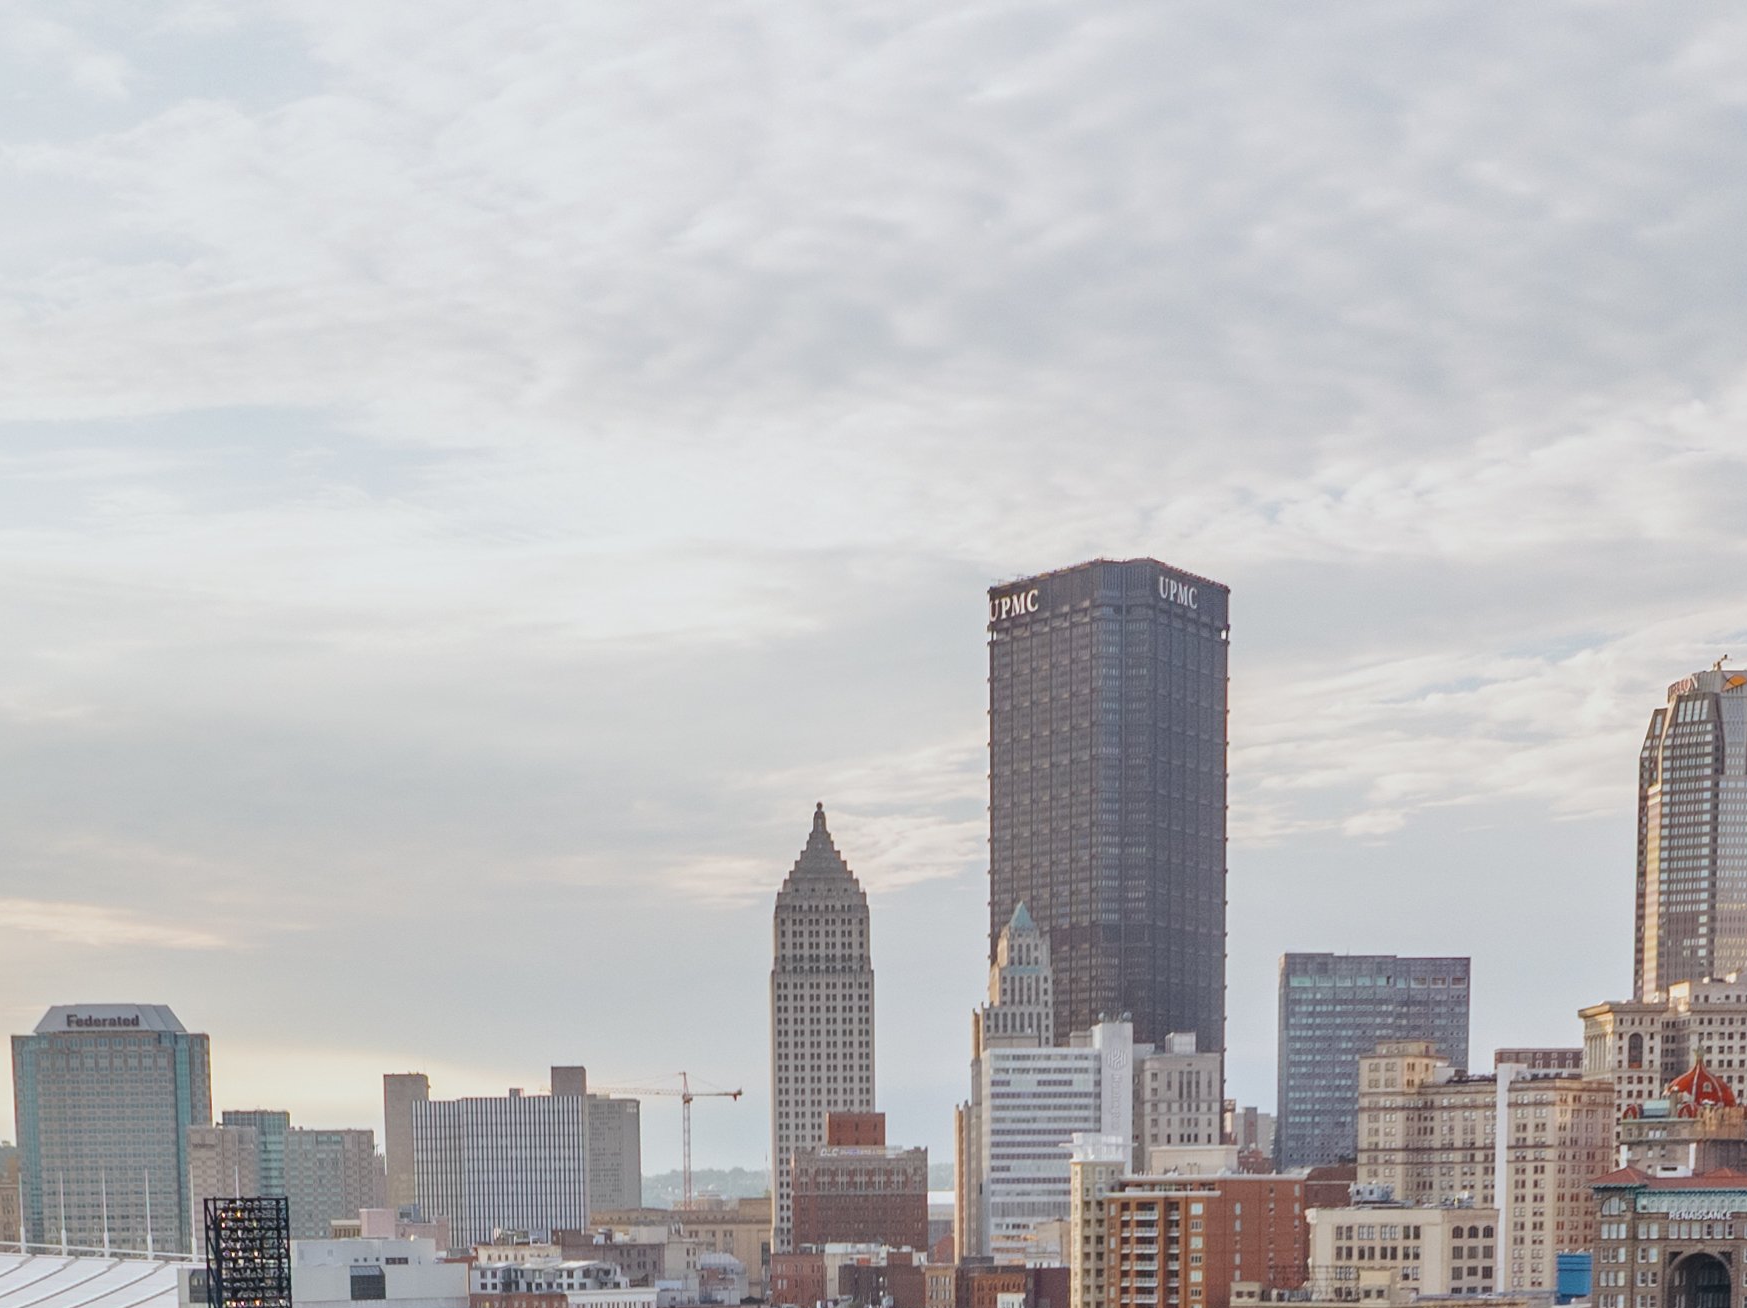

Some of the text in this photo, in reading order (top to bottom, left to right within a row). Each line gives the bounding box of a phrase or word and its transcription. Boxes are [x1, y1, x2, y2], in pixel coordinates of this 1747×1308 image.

[1158, 576, 1198, 610] UPMC
[989, 589, 1039, 622] UPMC
[66, 1014, 140, 1028] Federated
[1669, 1210, 1733, 1221] RENAISSANCE
